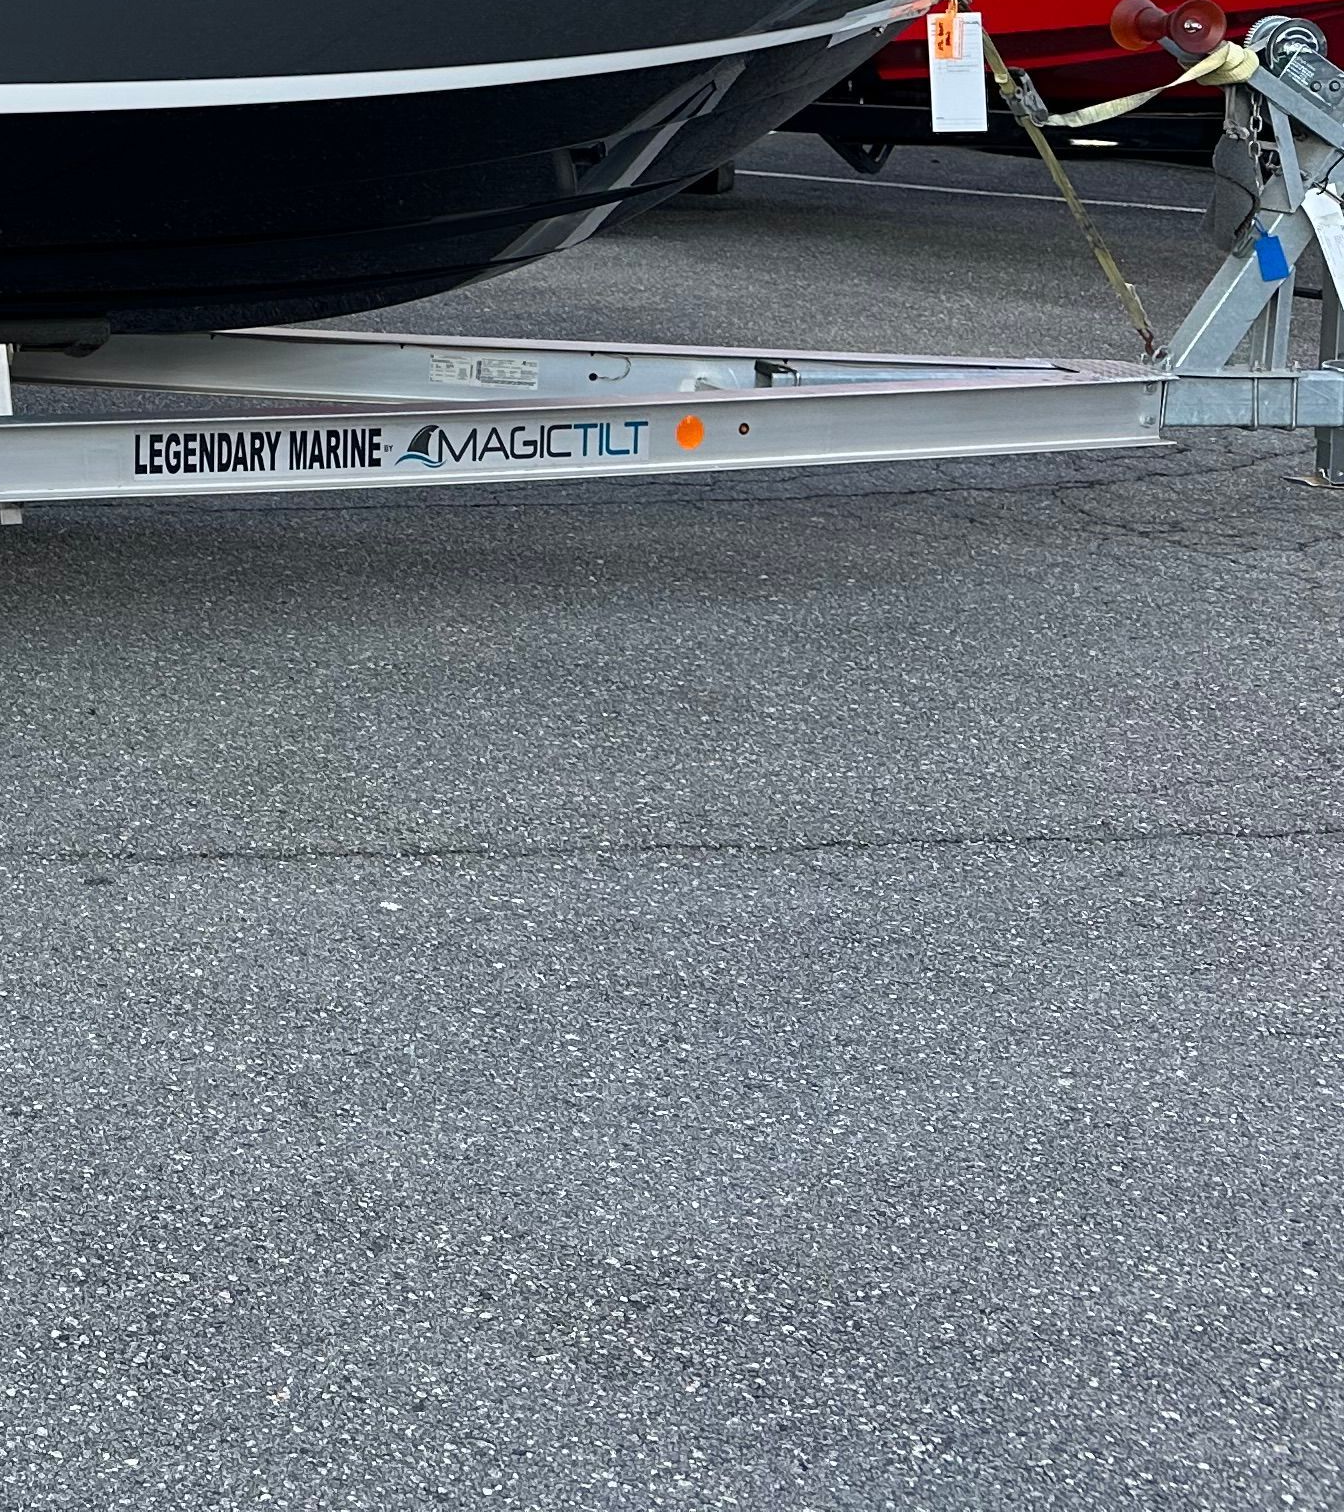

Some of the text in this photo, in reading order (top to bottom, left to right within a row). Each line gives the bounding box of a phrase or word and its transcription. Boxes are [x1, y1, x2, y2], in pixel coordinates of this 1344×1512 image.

[134, 431, 282, 475] LEGENDARY
[288, 428, 382, 471] MARINE
[438, 420, 649, 463] MAGICTILT
